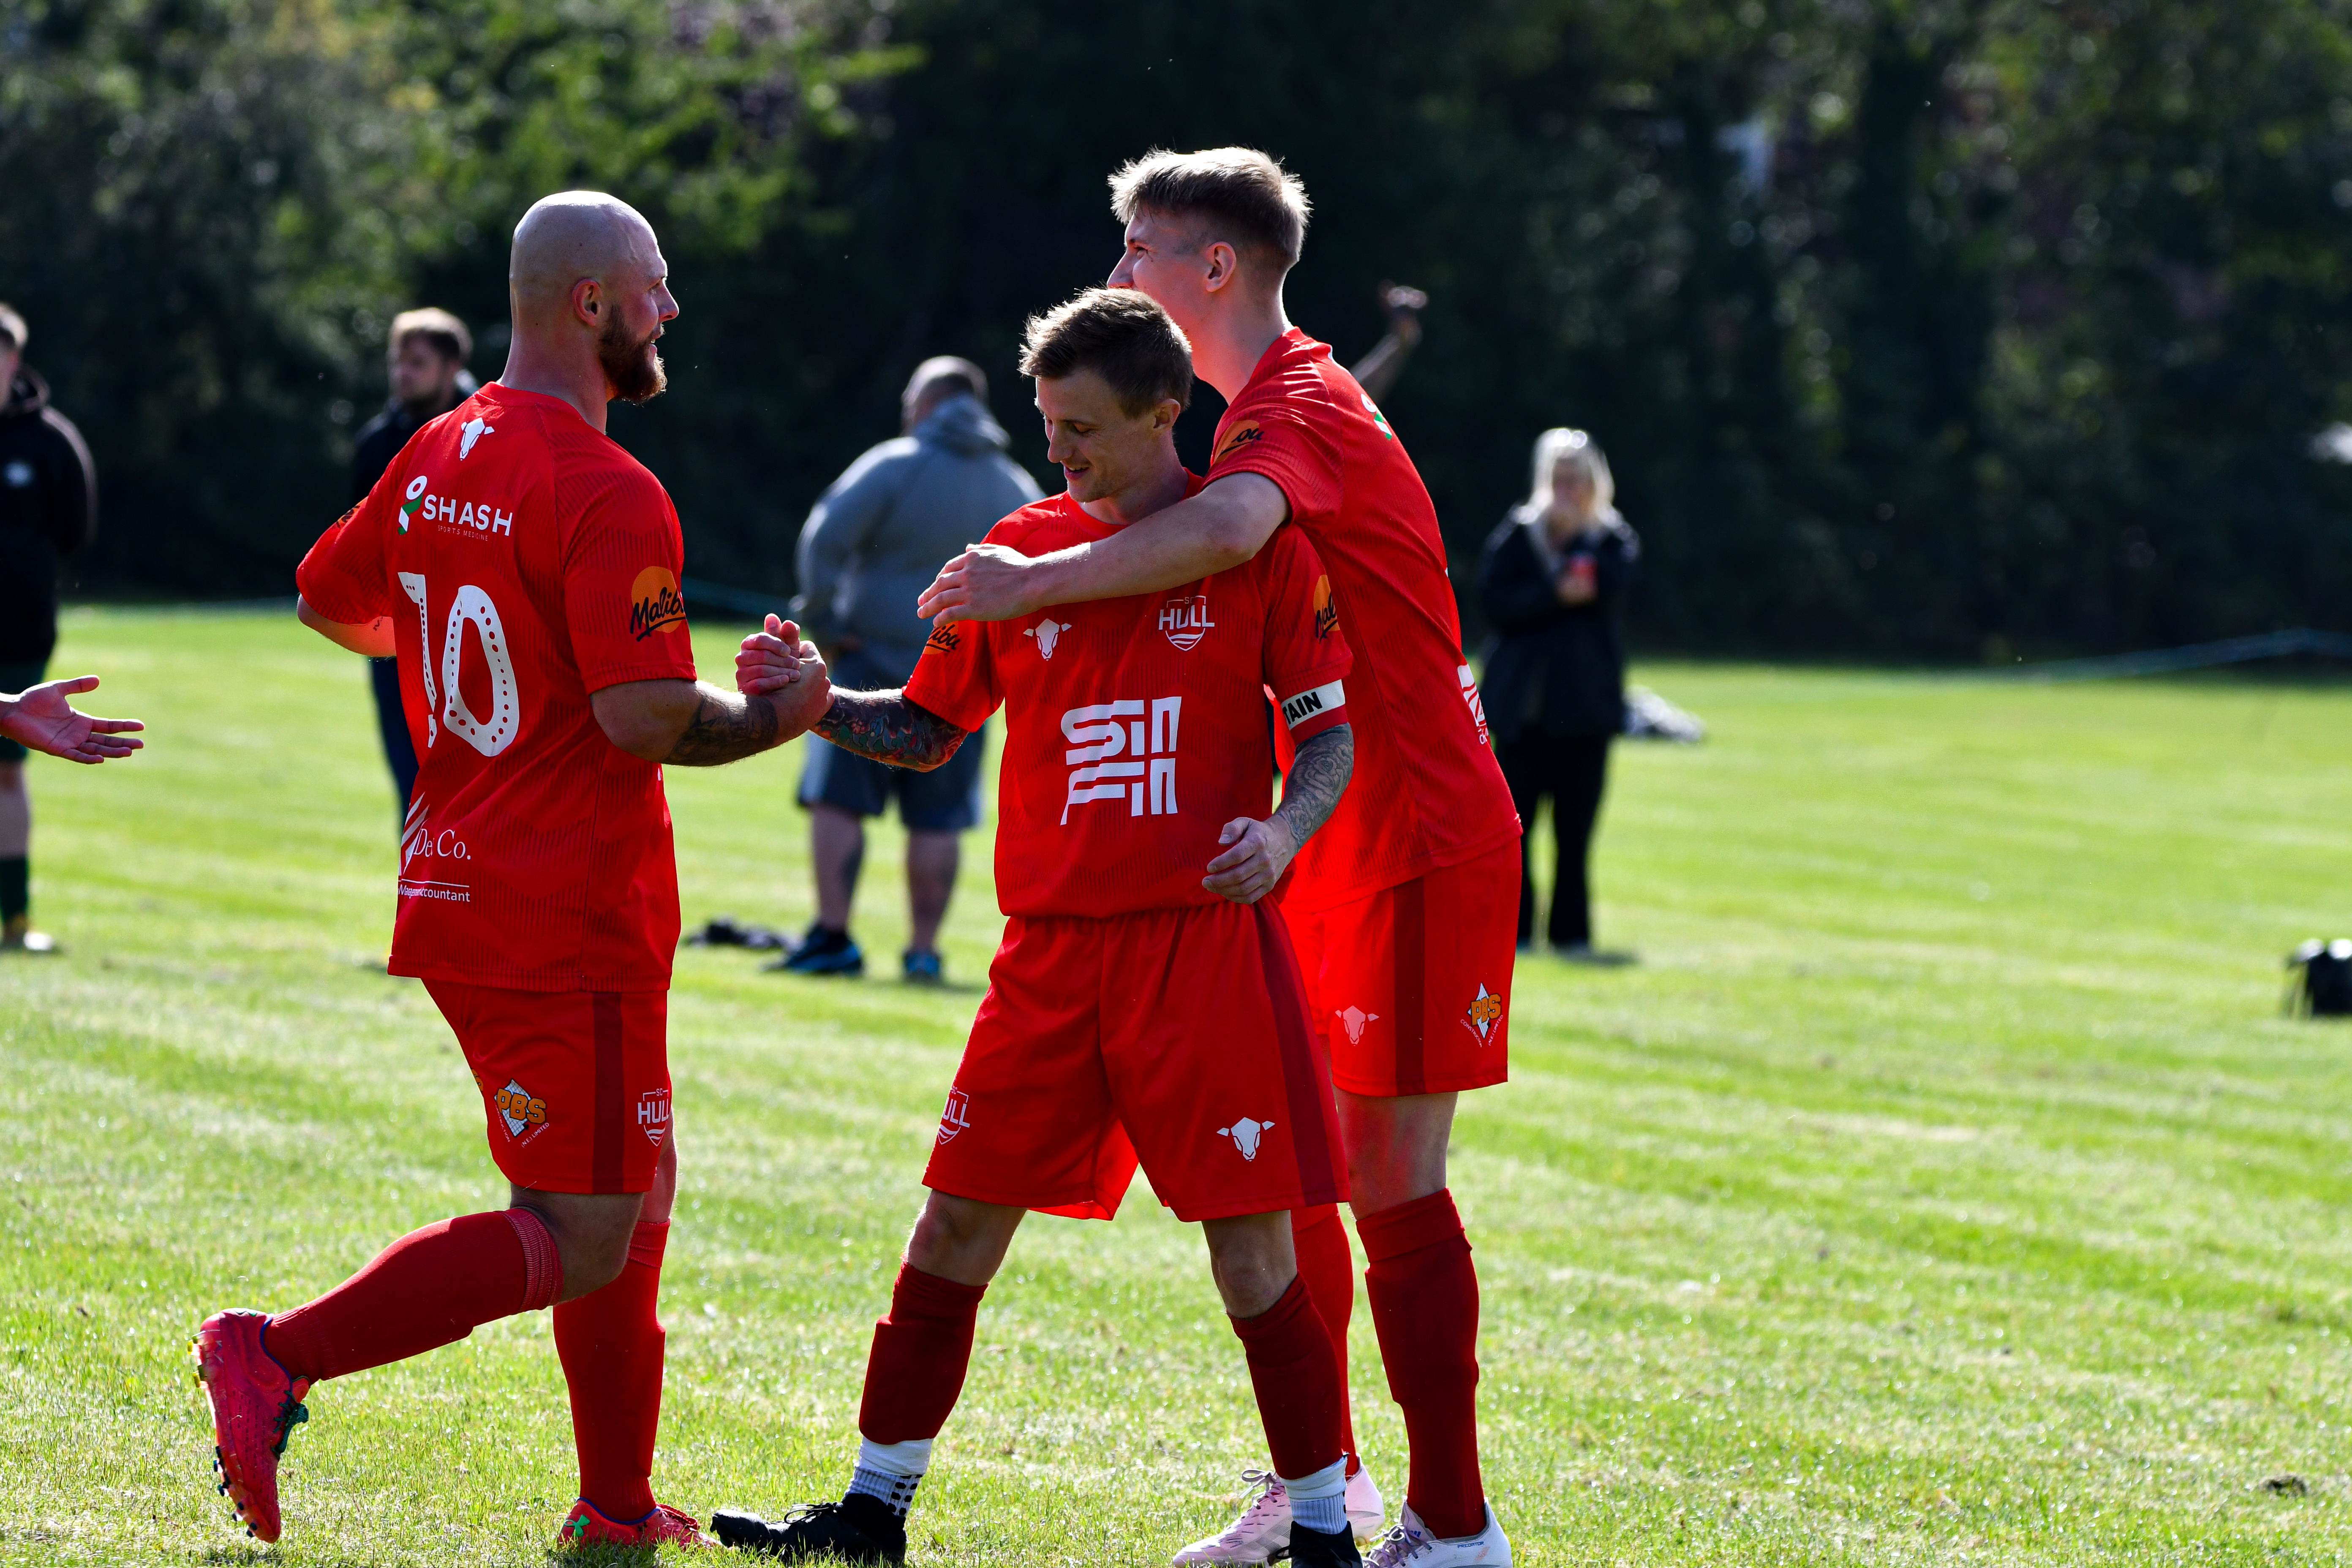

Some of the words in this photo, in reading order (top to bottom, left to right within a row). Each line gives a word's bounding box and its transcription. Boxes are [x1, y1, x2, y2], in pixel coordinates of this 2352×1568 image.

[422, 494, 513, 536] SHASH
[438, 525, 460, 535] SPORTS
[463, 530, 488, 542] MEDICINE
[630, 586, 685, 637] Malib
[1158, 604, 1215, 630] HULL
[397, 572, 520, 757] 10
[1282, 691, 1323, 725] TAIN
[437, 829, 471, 860] Co.
[421, 886, 471, 902] countant
[1470, 993, 1502, 1026] PBS
[495, 1087, 547, 1124] PBS
[656, 1088, 663, 1096] SC
[942, 1097, 971, 1128] ULL
[532, 1122, 550, 1138] LIMITED
